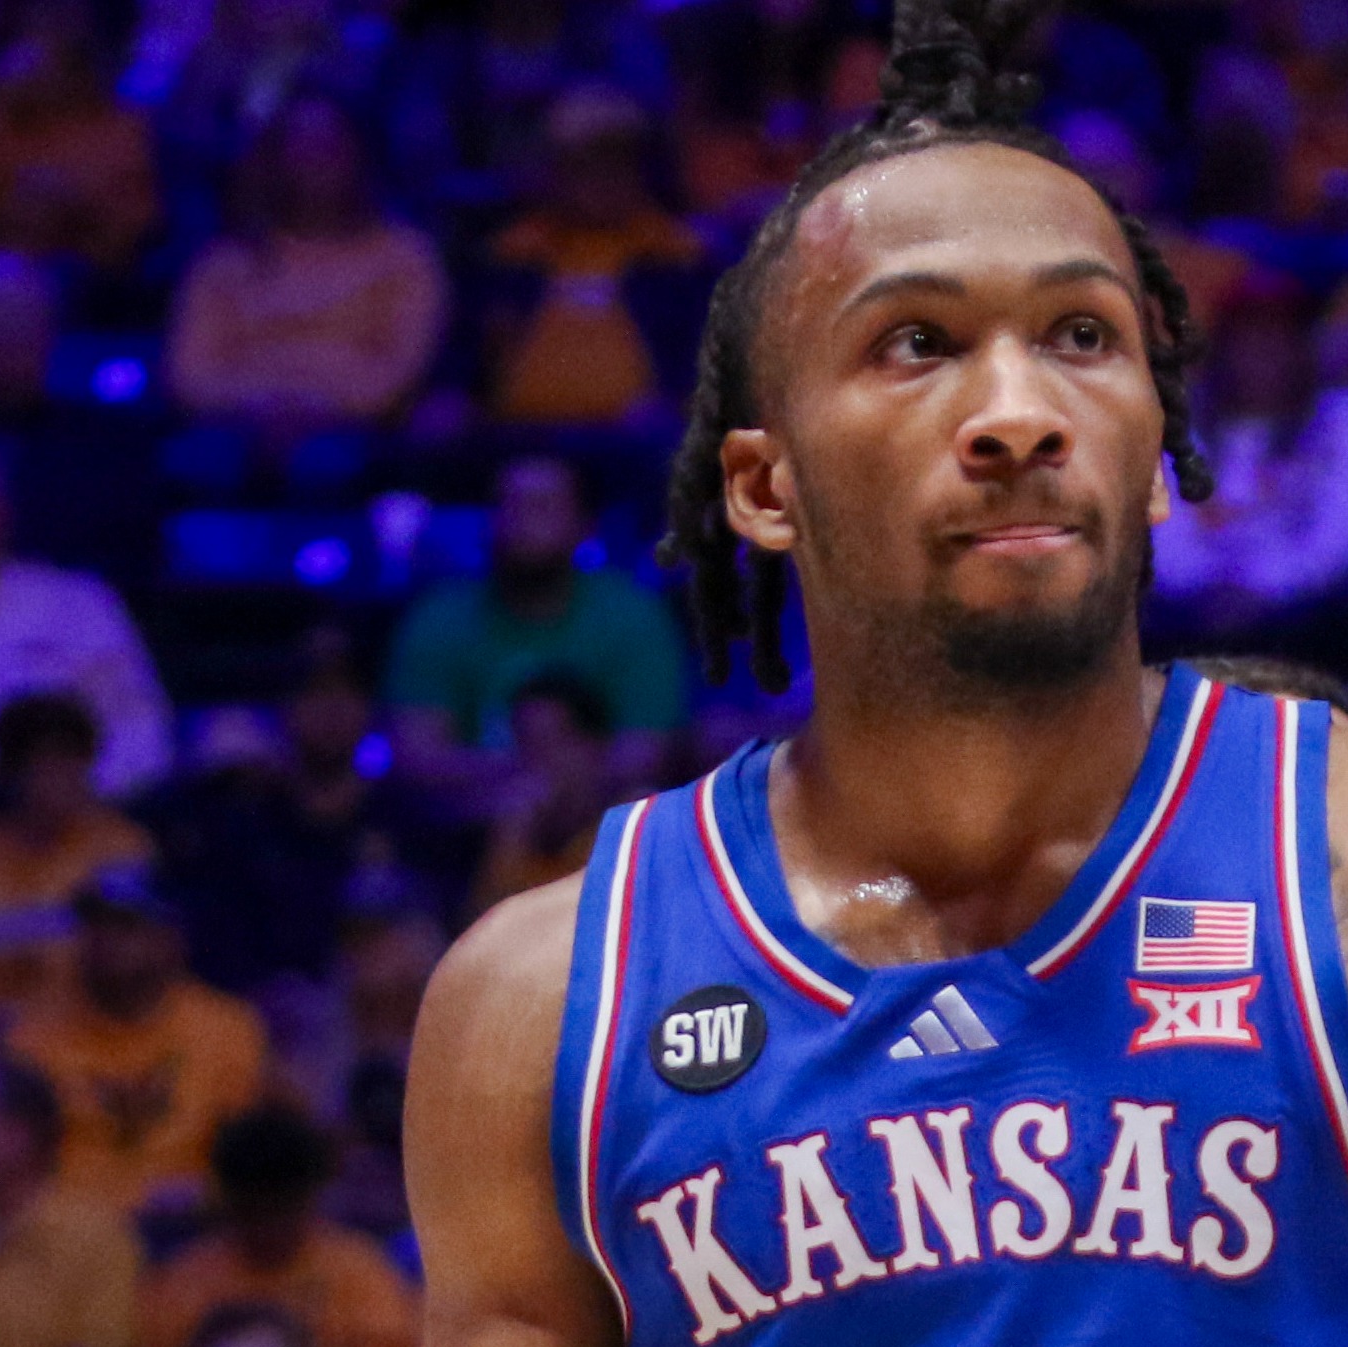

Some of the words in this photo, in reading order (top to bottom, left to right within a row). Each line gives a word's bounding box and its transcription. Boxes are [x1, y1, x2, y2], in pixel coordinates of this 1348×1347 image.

[662, 1003, 749, 1070] SW
[1136, 986, 1251, 1046] XII
[637, 1101, 1280, 1347] KANSAS
